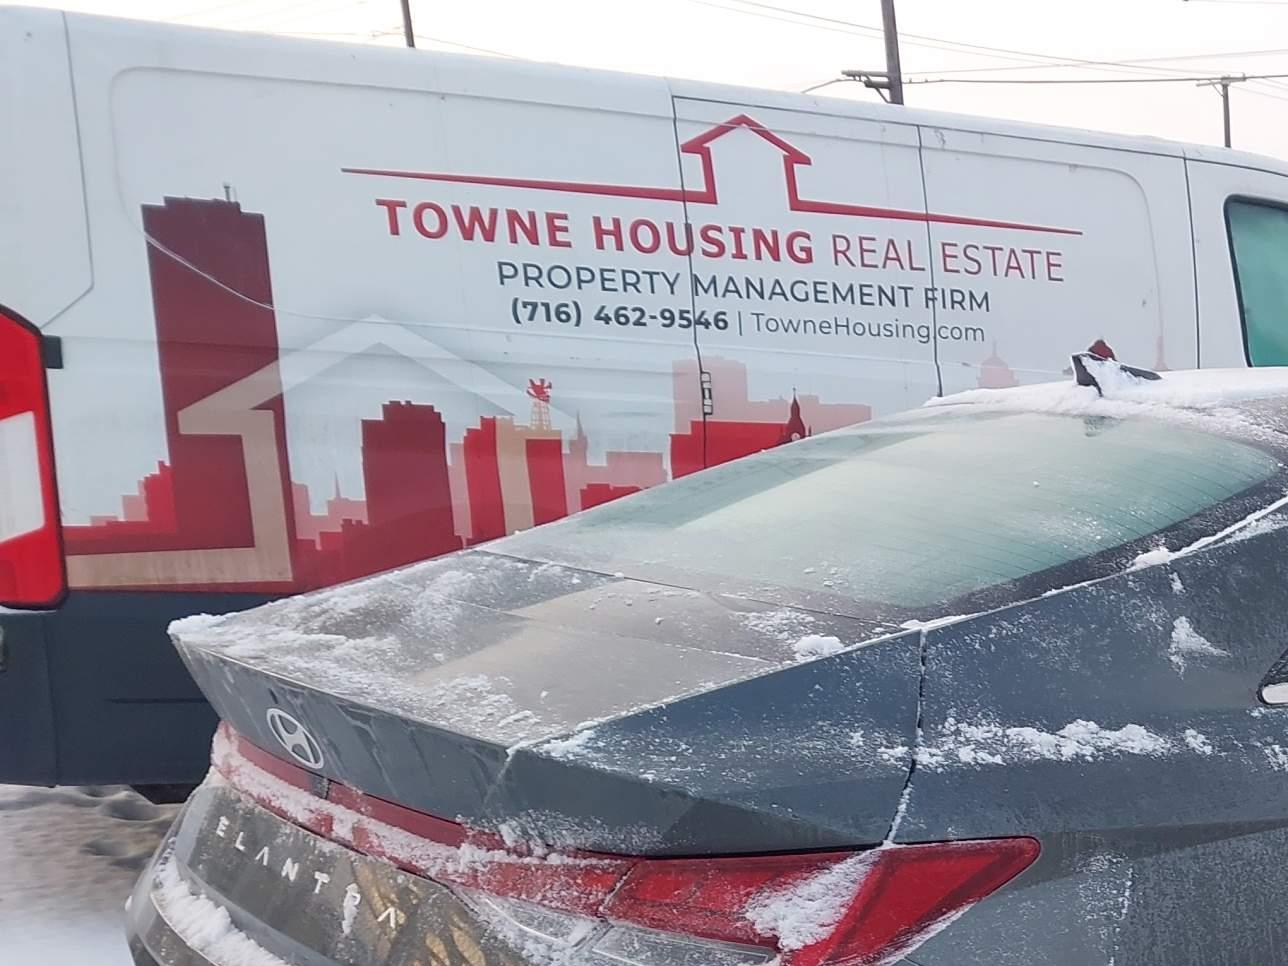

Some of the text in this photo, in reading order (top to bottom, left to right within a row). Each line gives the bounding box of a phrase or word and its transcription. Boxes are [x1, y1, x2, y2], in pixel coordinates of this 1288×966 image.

[375, 198, 1065, 282] TOWNE HOUSING REAL ESTATE
[497, 260, 991, 313] PROPERTY MANAGEMENT FIRM
[511, 297, 583, 327] (716)
[594, 304, 729, 331] 462-9546
[750, 311, 985, 344] TowneHousing.com
